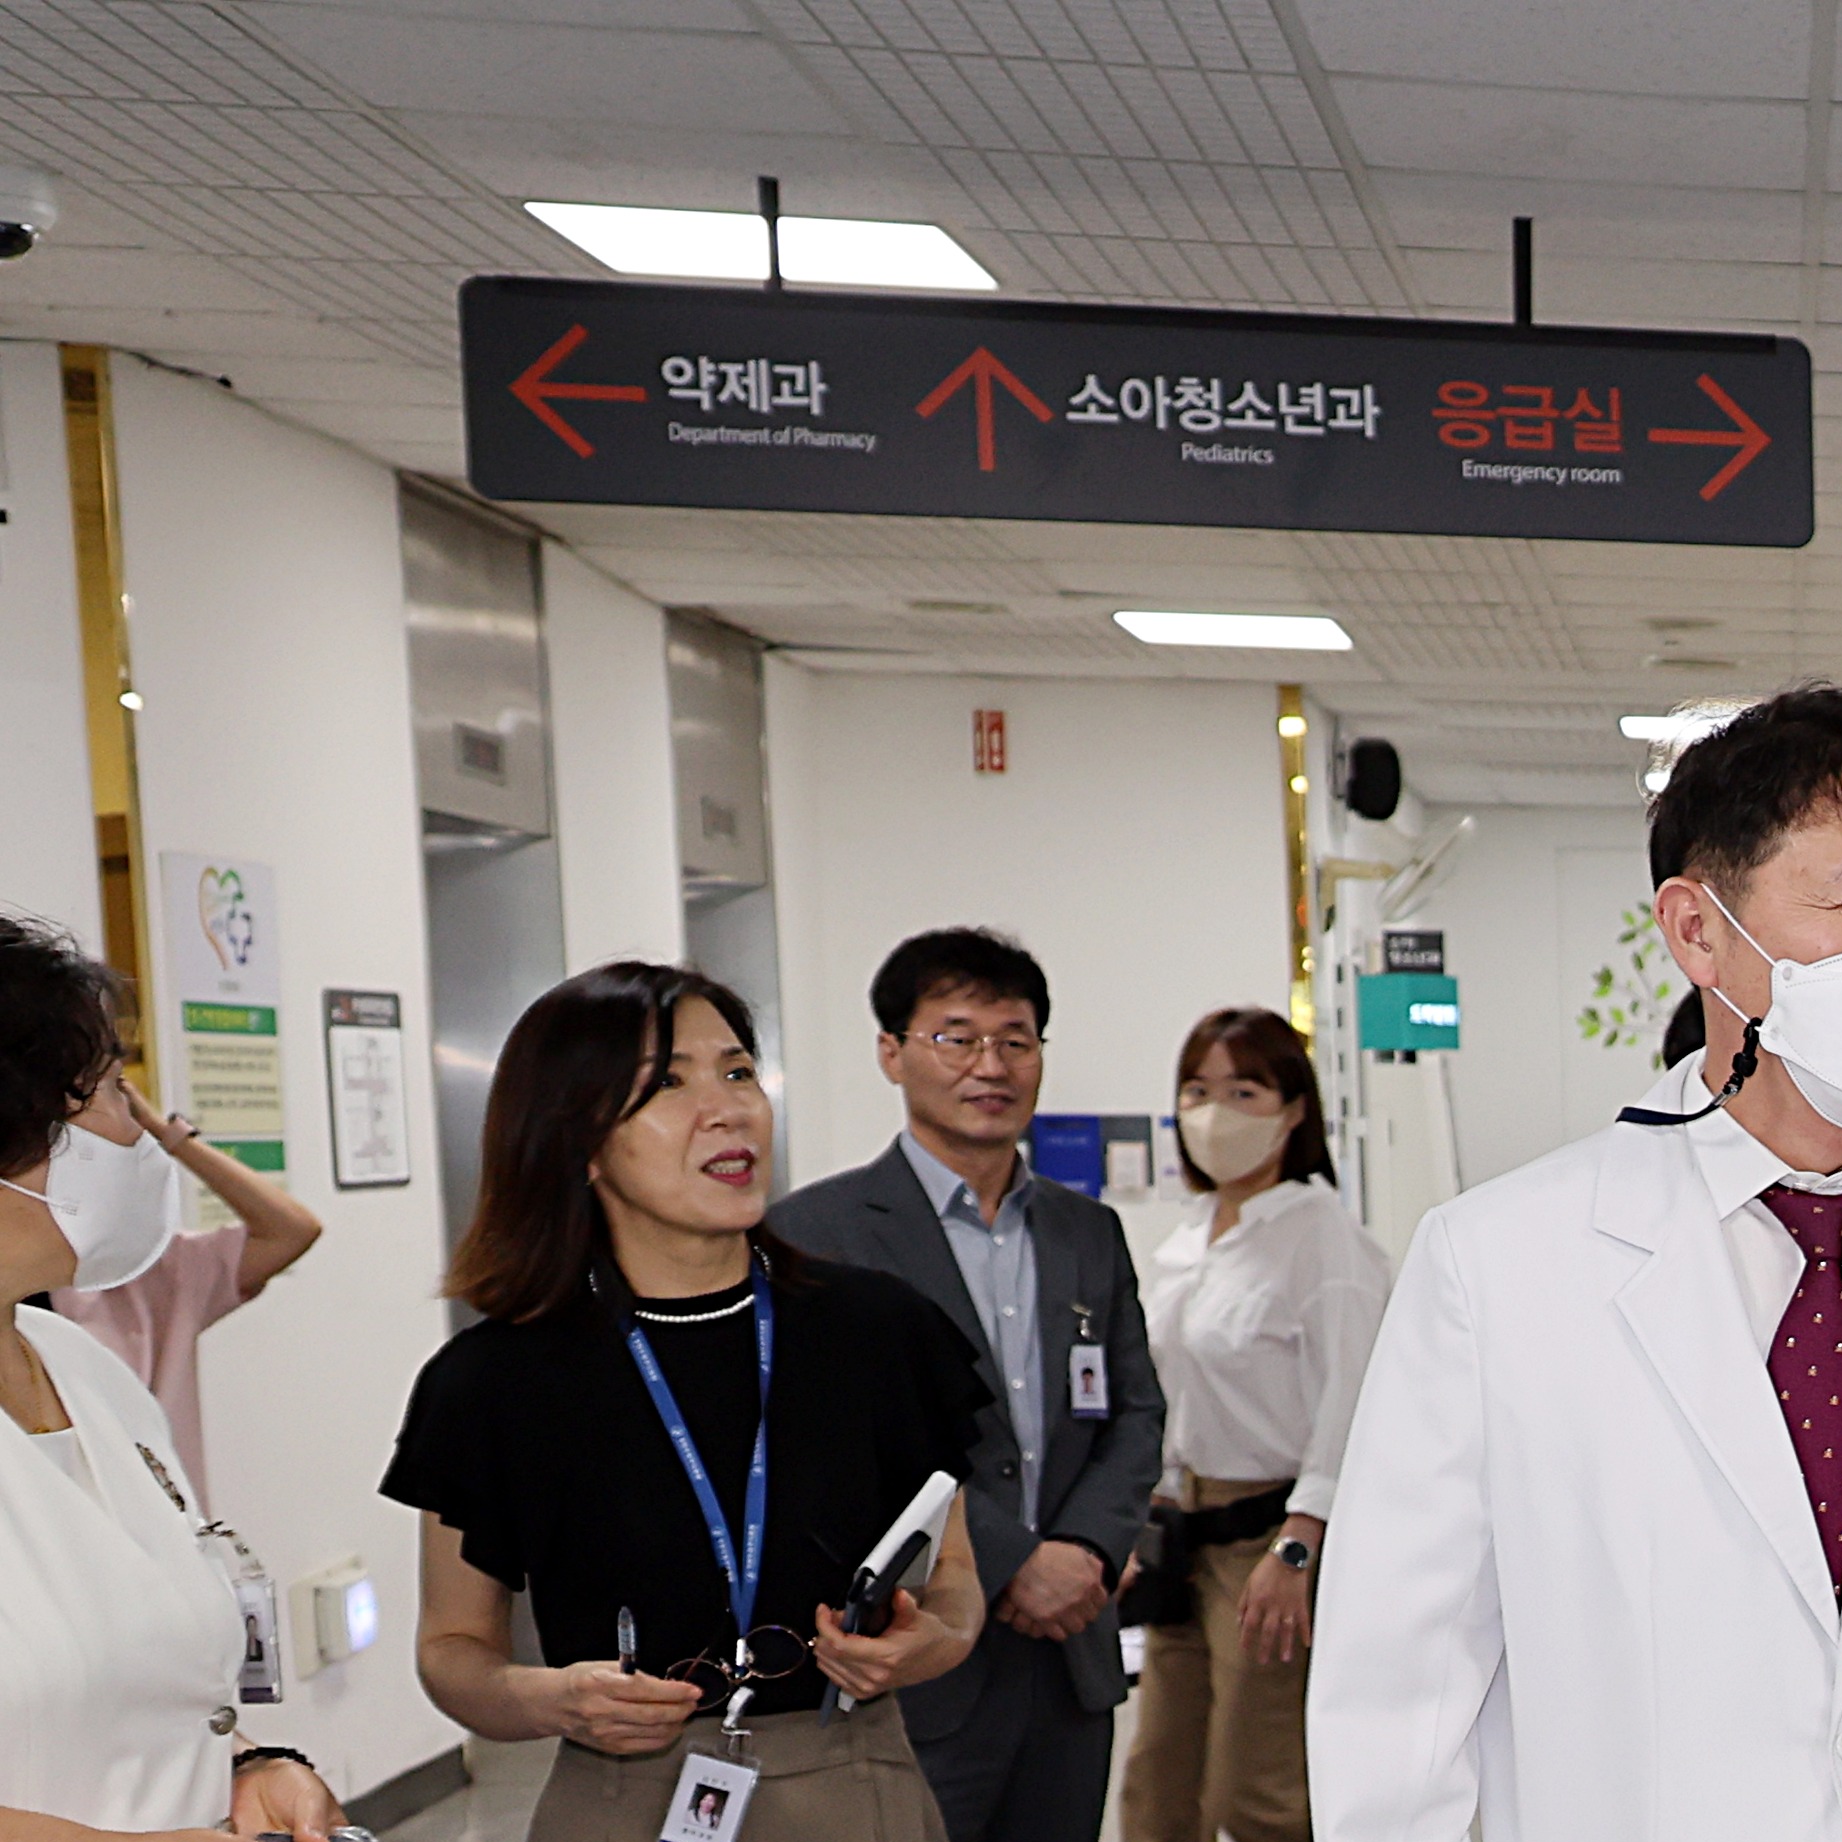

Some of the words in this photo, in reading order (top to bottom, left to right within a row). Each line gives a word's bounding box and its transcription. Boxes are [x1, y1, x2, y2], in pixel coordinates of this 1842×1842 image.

[660, 355, 828, 415] 약제과
[1066, 373, 1382, 439] 소아청소년과
[668, 421, 770, 446] Department
[772, 426, 791, 444] of
[793, 427, 876, 451] Pharmacy
[1431, 380, 1624, 453] 응급실
[1181, 442, 1275, 466] Pediatrics
[1461, 458, 1567, 485] Emergency
[1571, 468, 1622, 483] room
